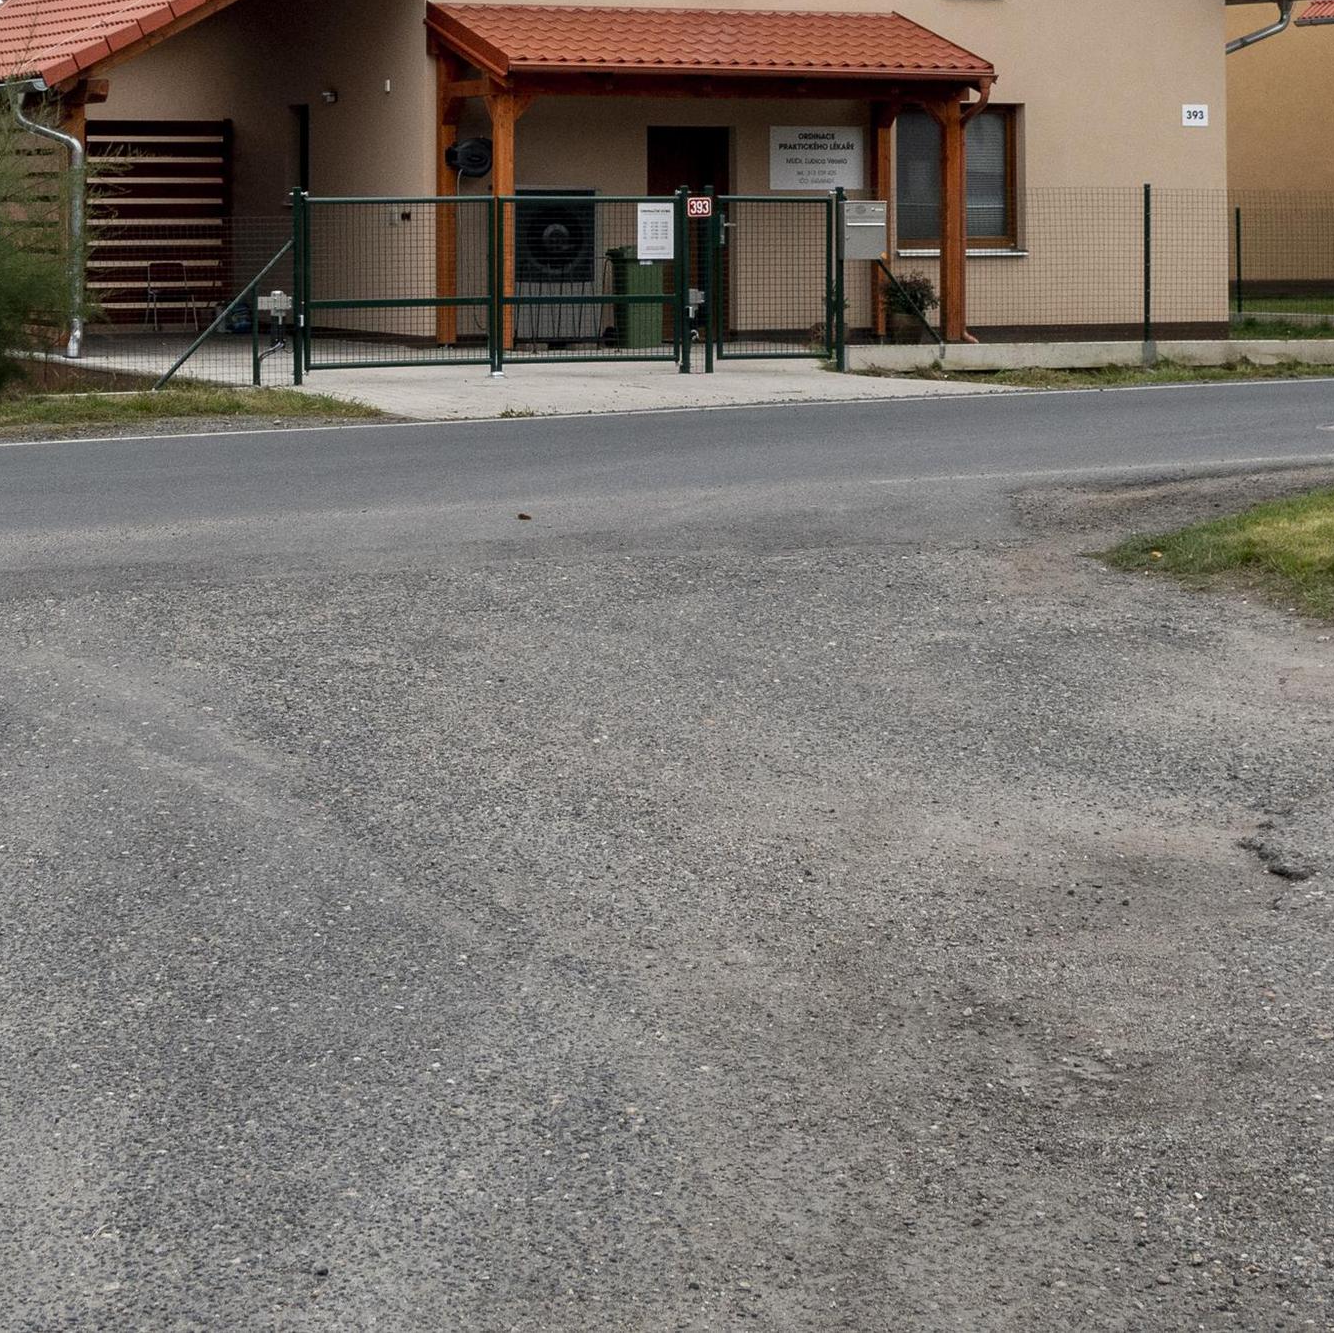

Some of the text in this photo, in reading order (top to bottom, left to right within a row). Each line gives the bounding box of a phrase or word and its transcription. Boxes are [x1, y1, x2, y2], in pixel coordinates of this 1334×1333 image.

[1186, 110, 1204, 120] 393
[778, 141, 855, 150] PRAKTICKÉHO LÉKAŘE
[690, 200, 709, 214] 393
